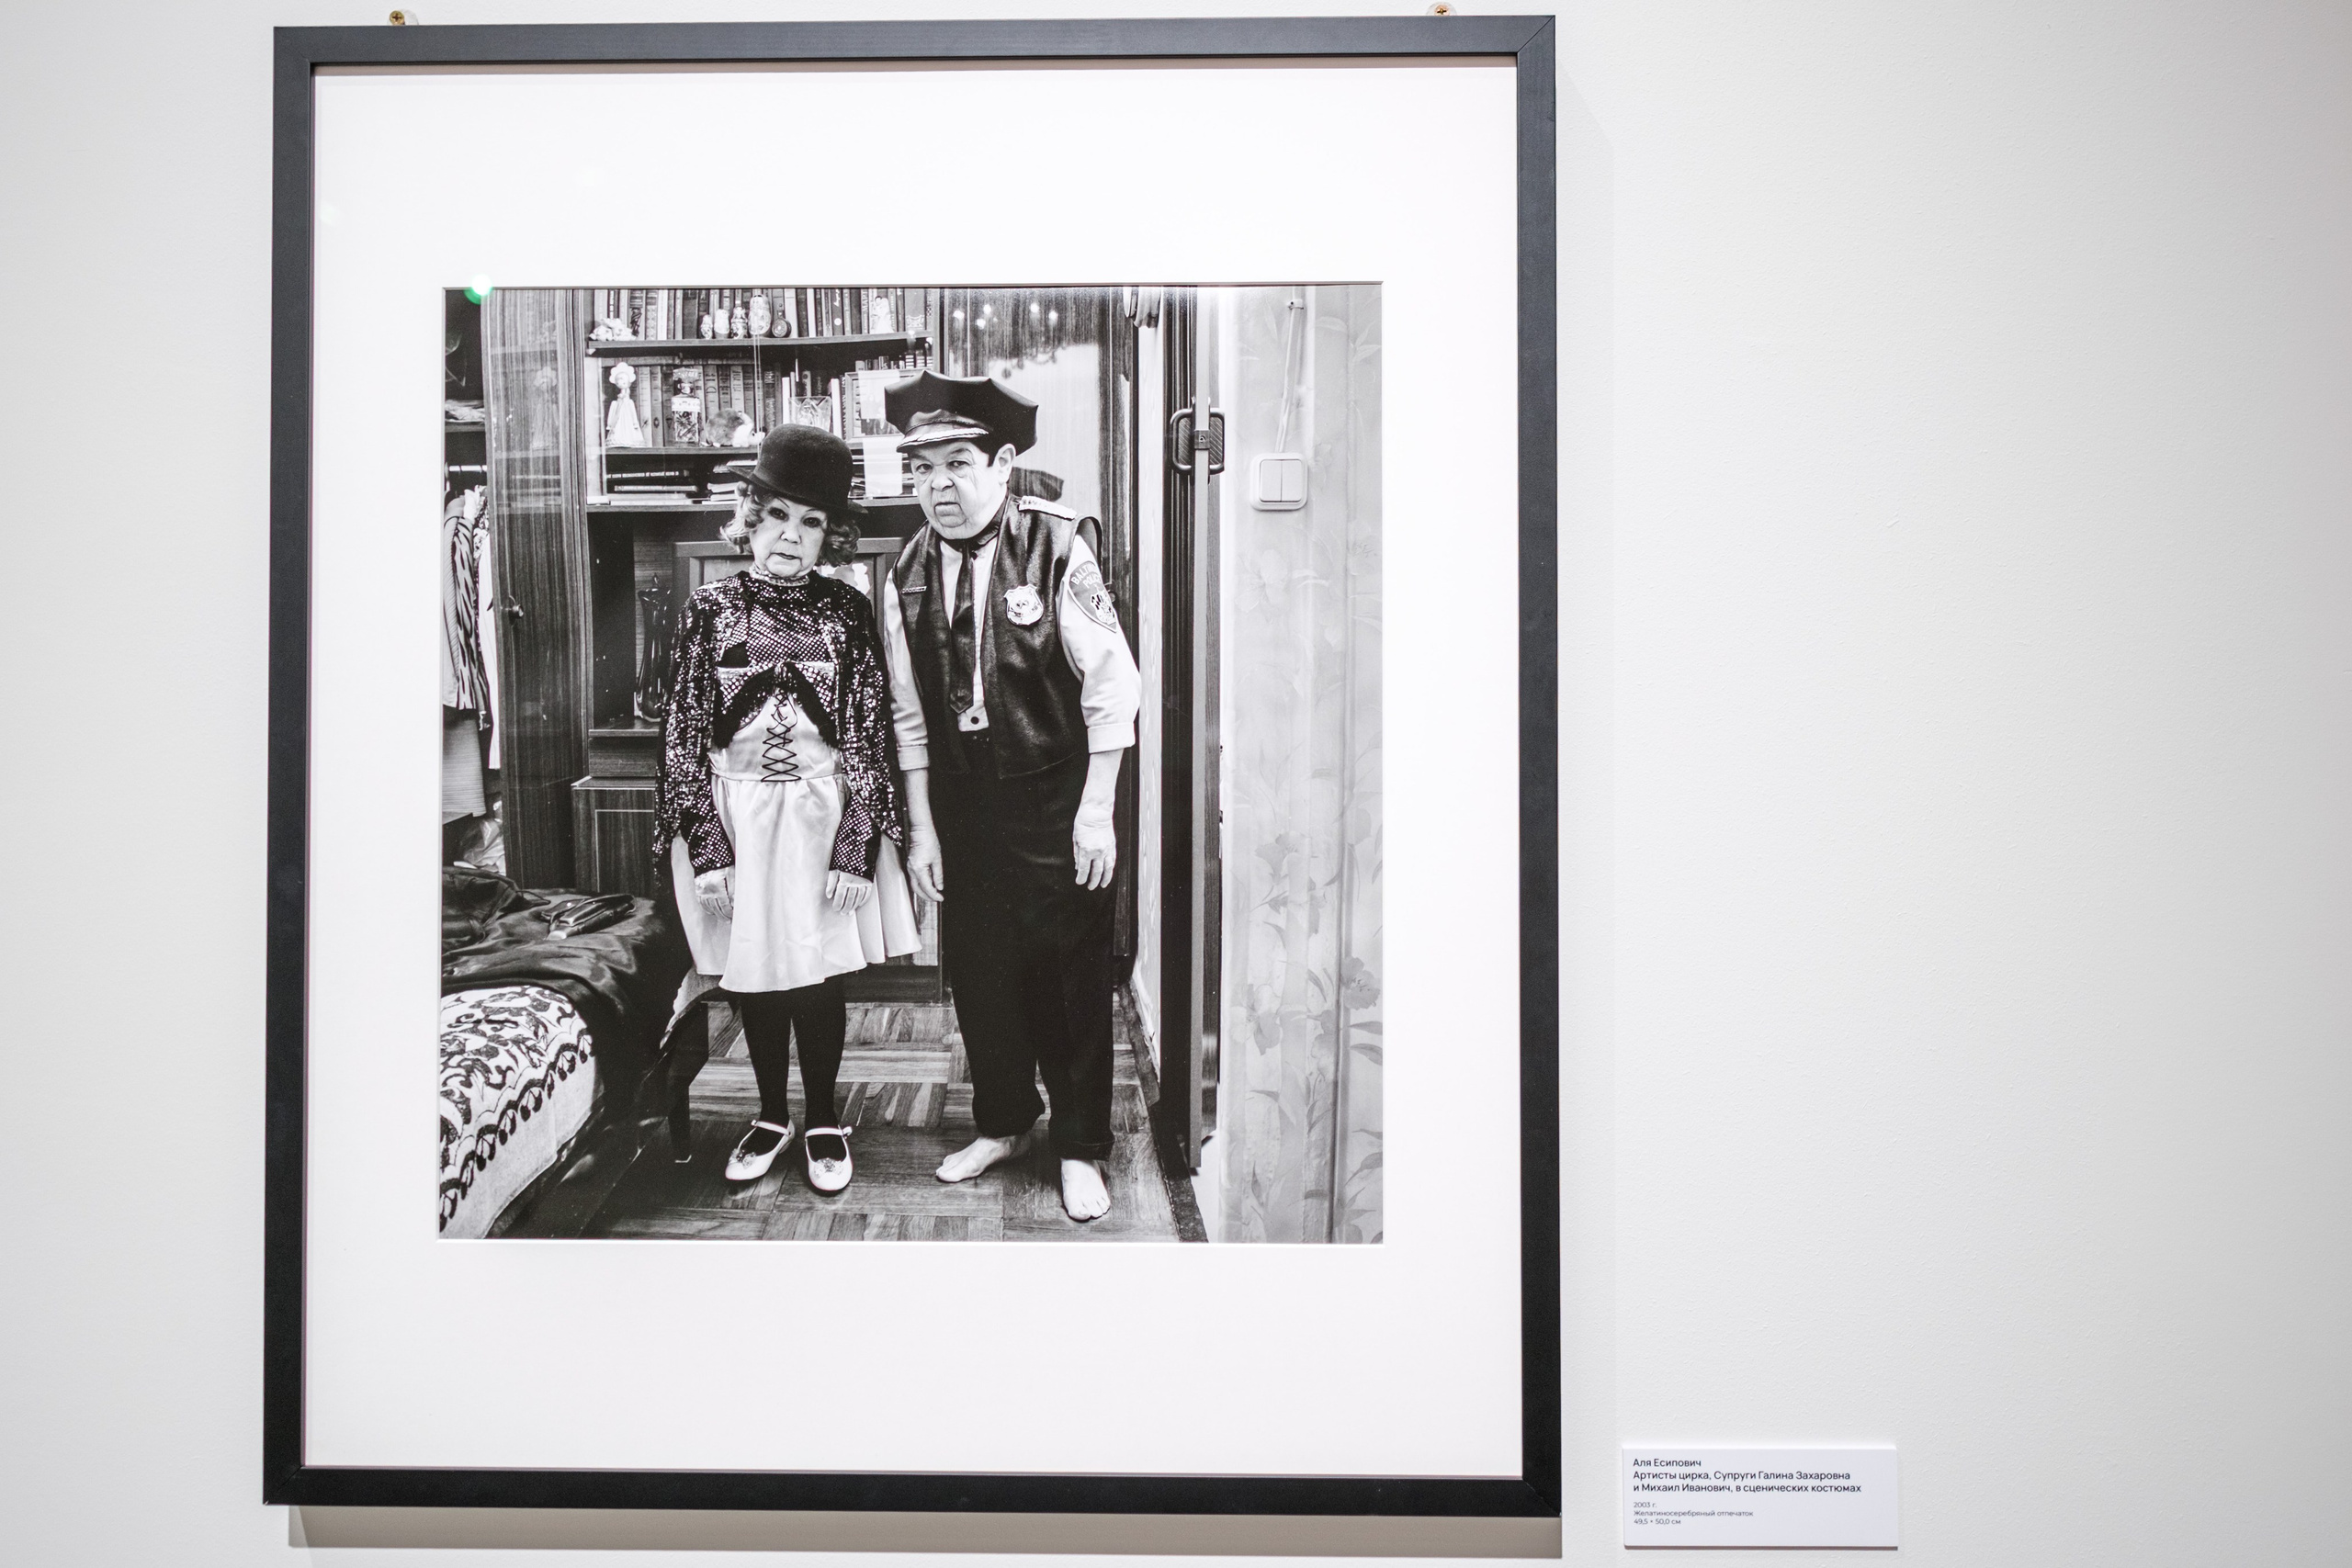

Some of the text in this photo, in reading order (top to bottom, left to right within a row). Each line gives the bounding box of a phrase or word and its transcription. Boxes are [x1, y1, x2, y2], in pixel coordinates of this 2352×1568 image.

[1633, 1458, 1702, 1467] Аля Есипович
[1633, 1471, 1850, 1482] Артисты цирка, Супруги Галина Захаровна
[1641, 1483, 1680, 1492] Михаил
[1681, 1483, 1734, 1493] Иванович,
[1743, 1484, 1809, 1493] сценических
